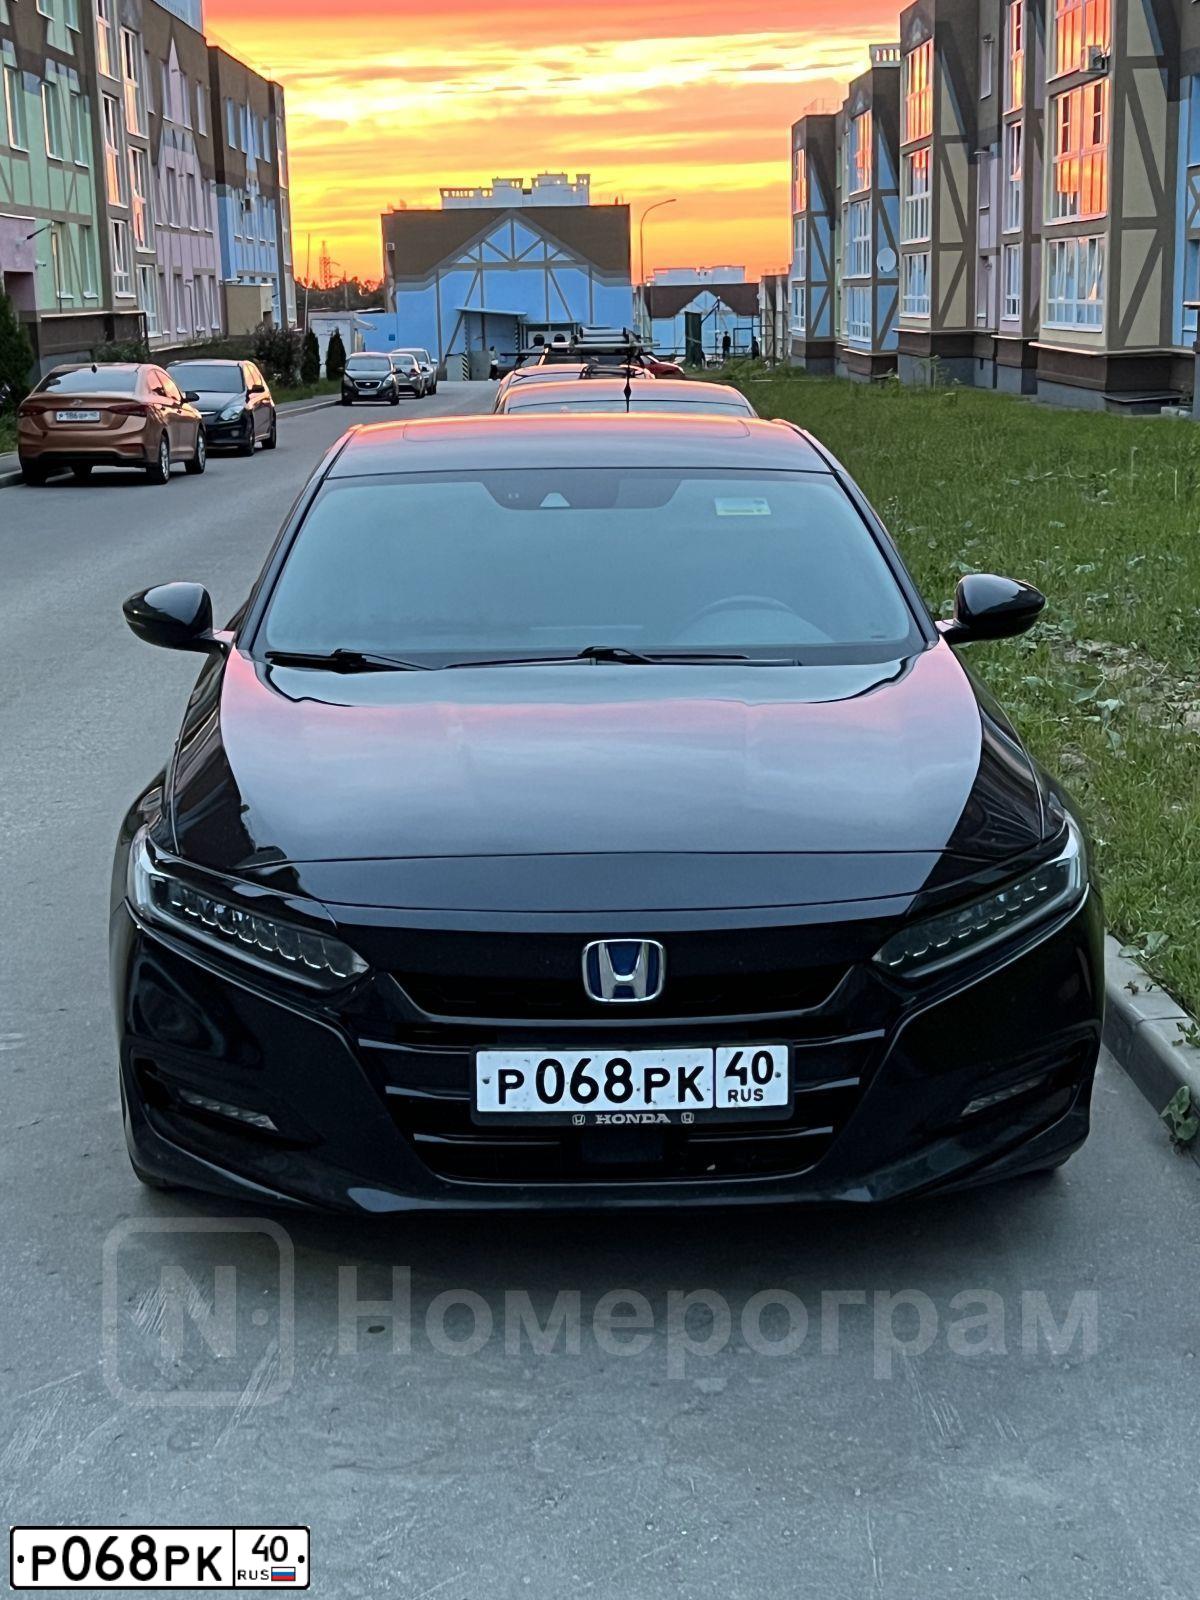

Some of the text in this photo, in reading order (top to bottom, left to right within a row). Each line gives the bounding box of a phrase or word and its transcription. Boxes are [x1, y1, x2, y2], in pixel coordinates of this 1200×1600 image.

[724, 1050, 774, 1086] 40
[727, 1088, 764, 1103] RUS
[595, 1113, 671, 1125] HONDA
